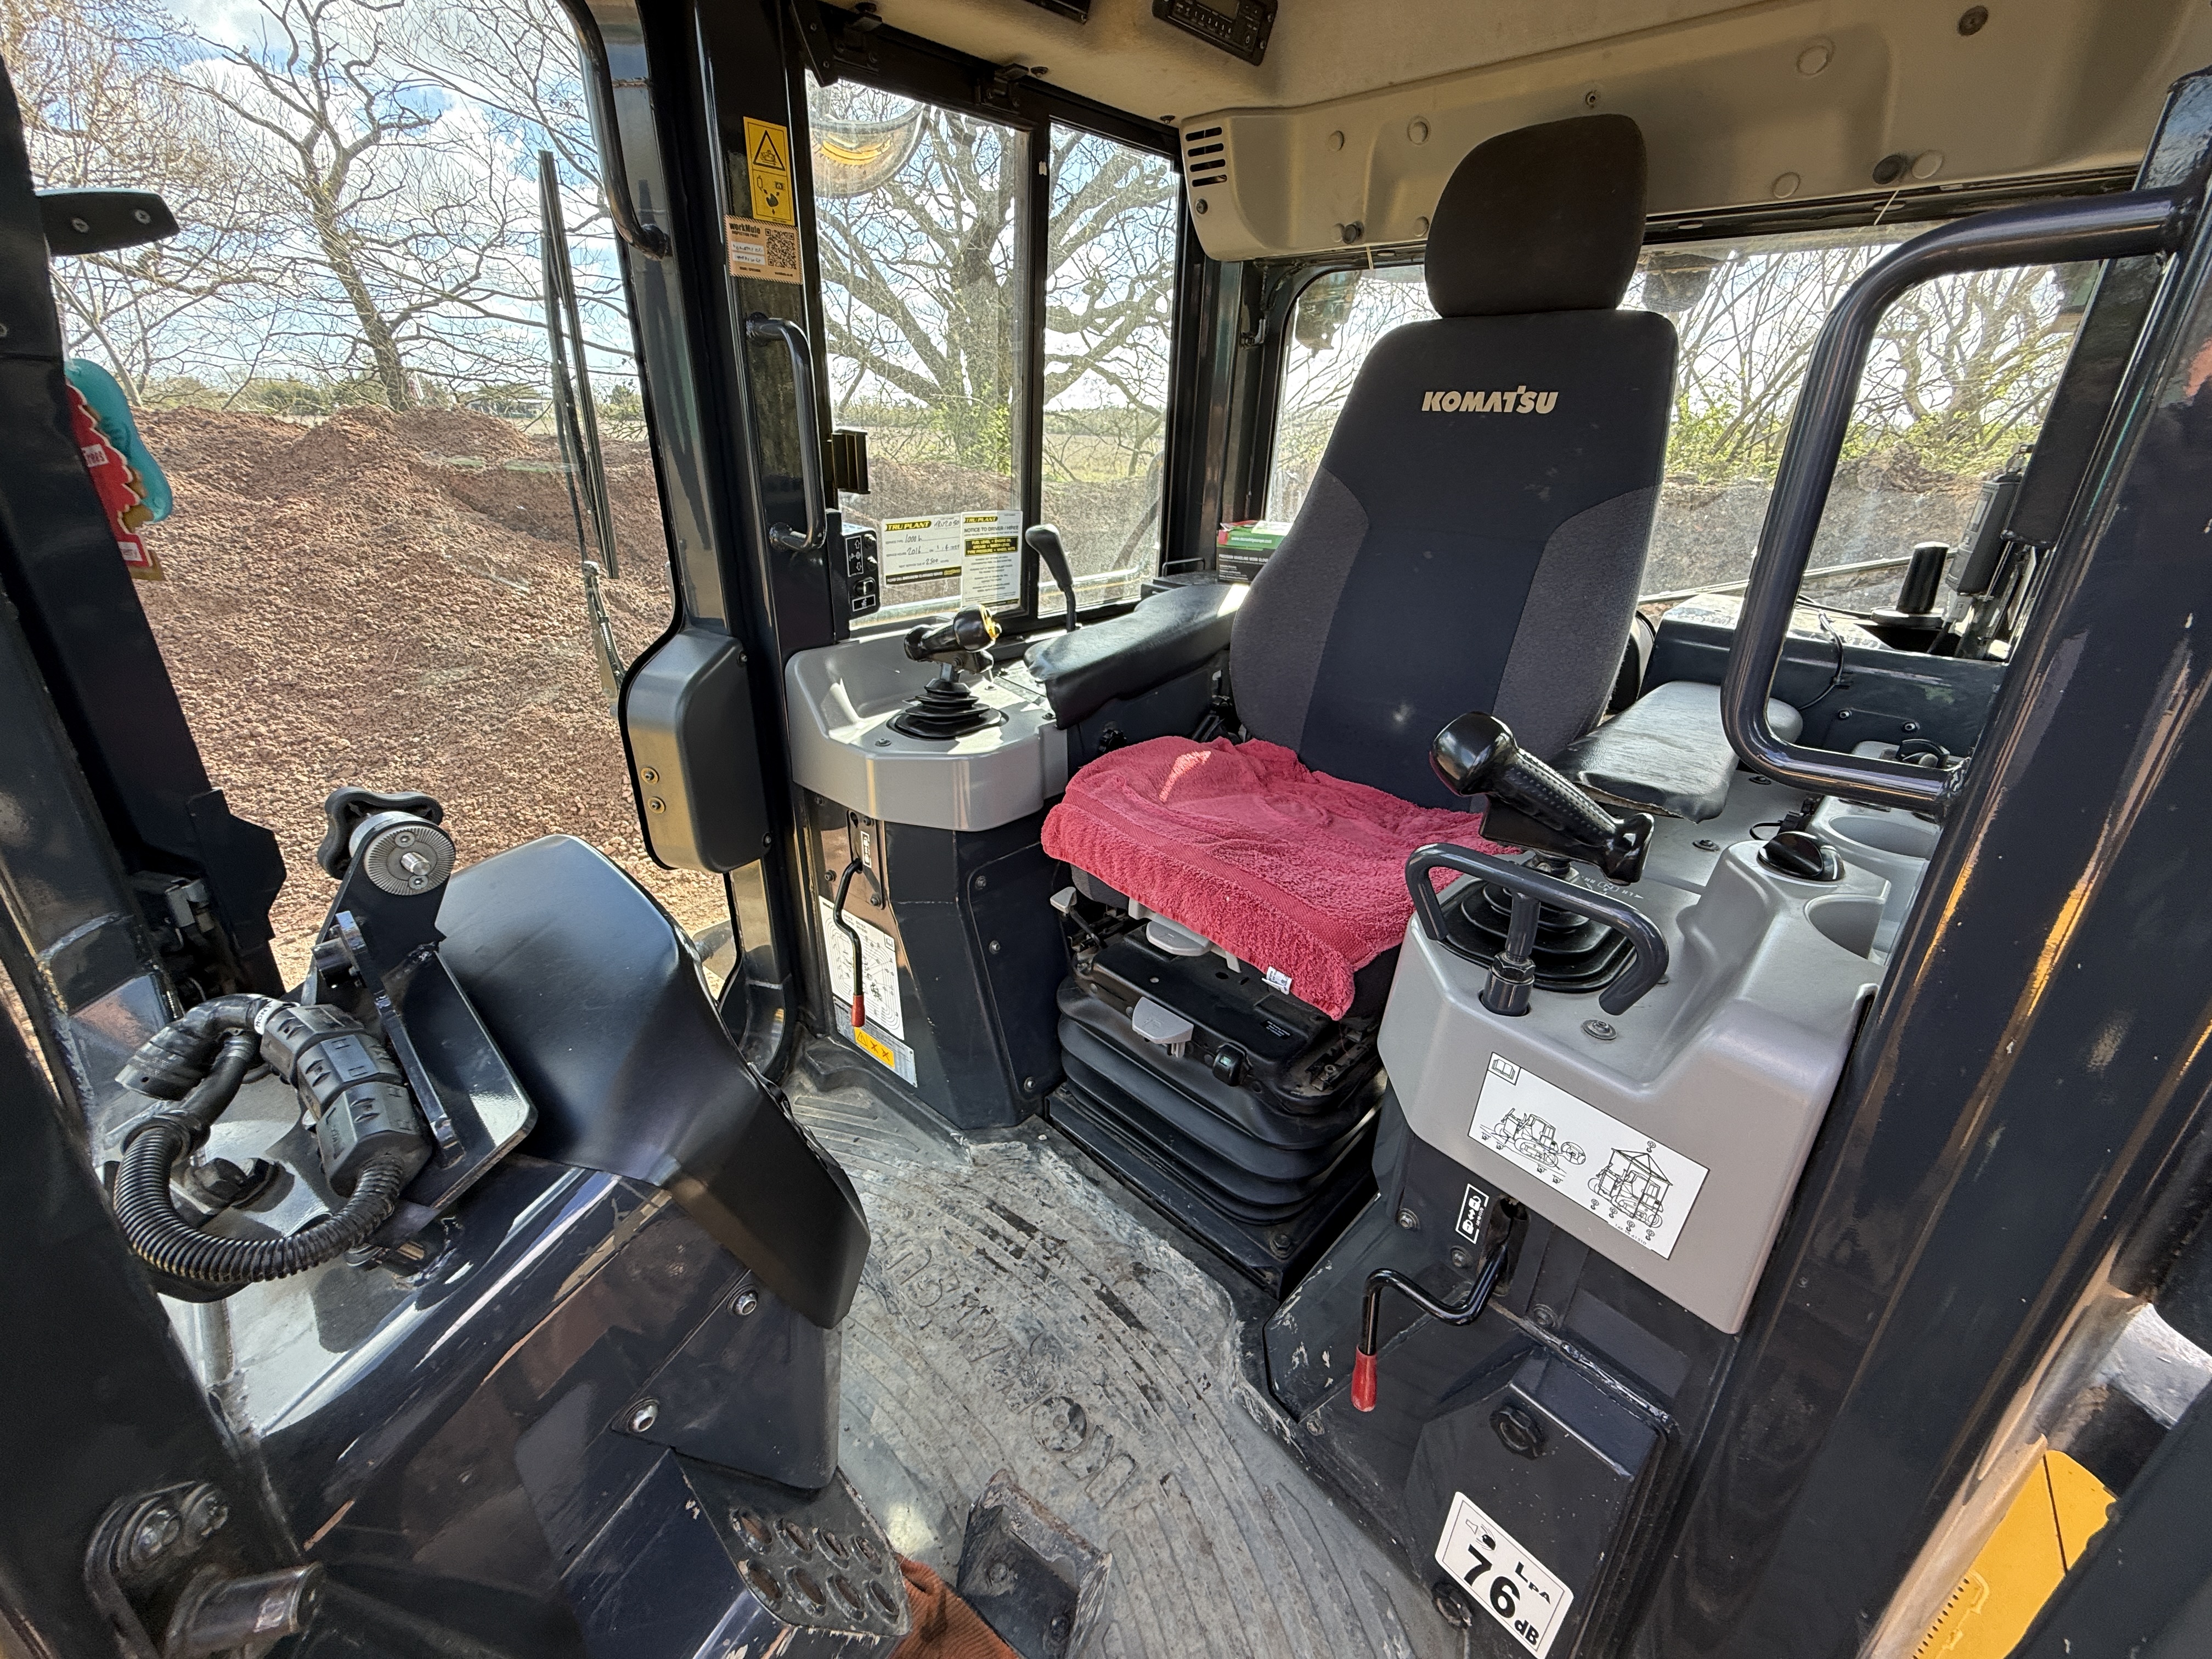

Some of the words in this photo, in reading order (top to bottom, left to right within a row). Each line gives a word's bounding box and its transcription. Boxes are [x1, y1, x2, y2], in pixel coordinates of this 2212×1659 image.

[729, 223, 761, 234] workMule
[1421, 385, 1559, 414] KOMATSU
[1463, 1543, 1521, 1619] 76
[1514, 1619, 1539, 1646] dB
